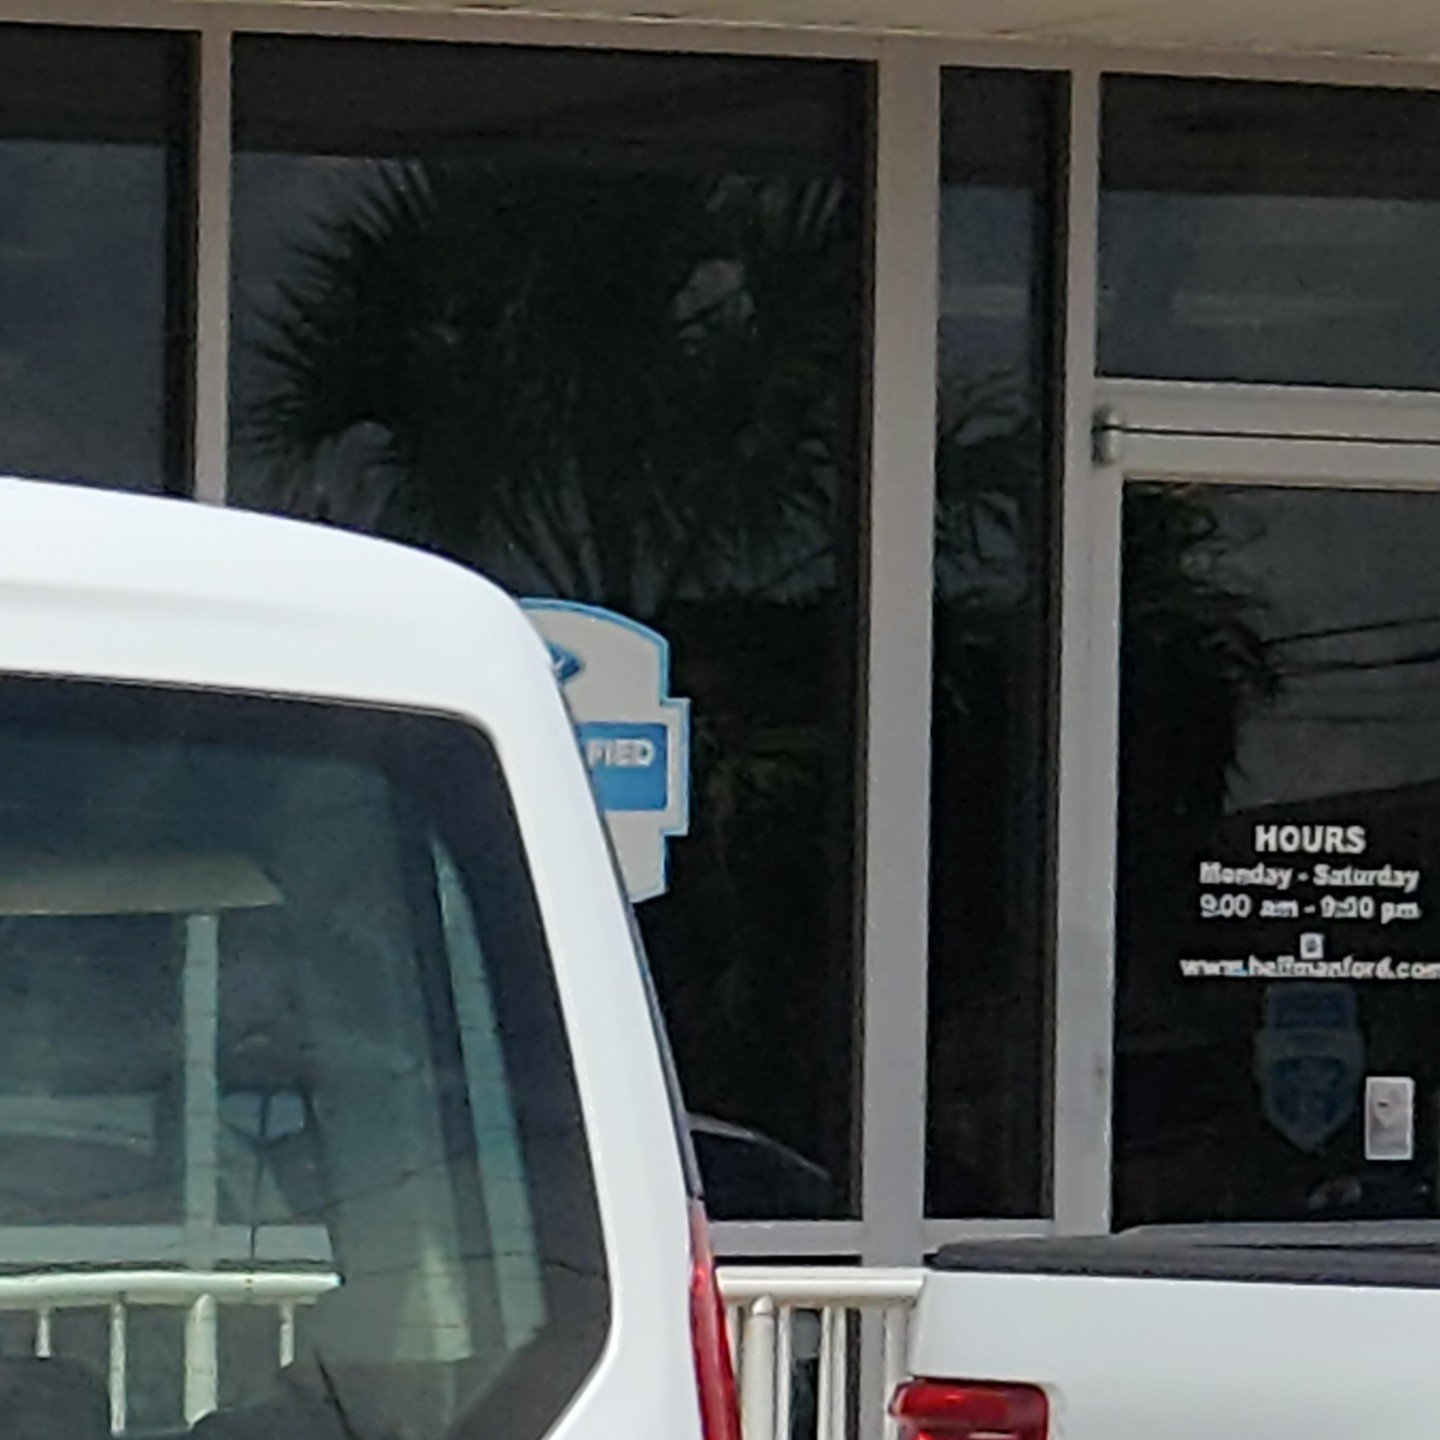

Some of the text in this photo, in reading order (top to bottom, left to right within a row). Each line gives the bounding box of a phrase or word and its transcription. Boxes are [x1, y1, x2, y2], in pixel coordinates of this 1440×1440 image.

[1254, 824, 1367, 854] HOURS
[1198, 861, 1294, 891] Monday
[1312, 863, 1421, 894] Saturday
[1258, 899, 1300, 919] am
[1380, 901, 1423, 925] pm
